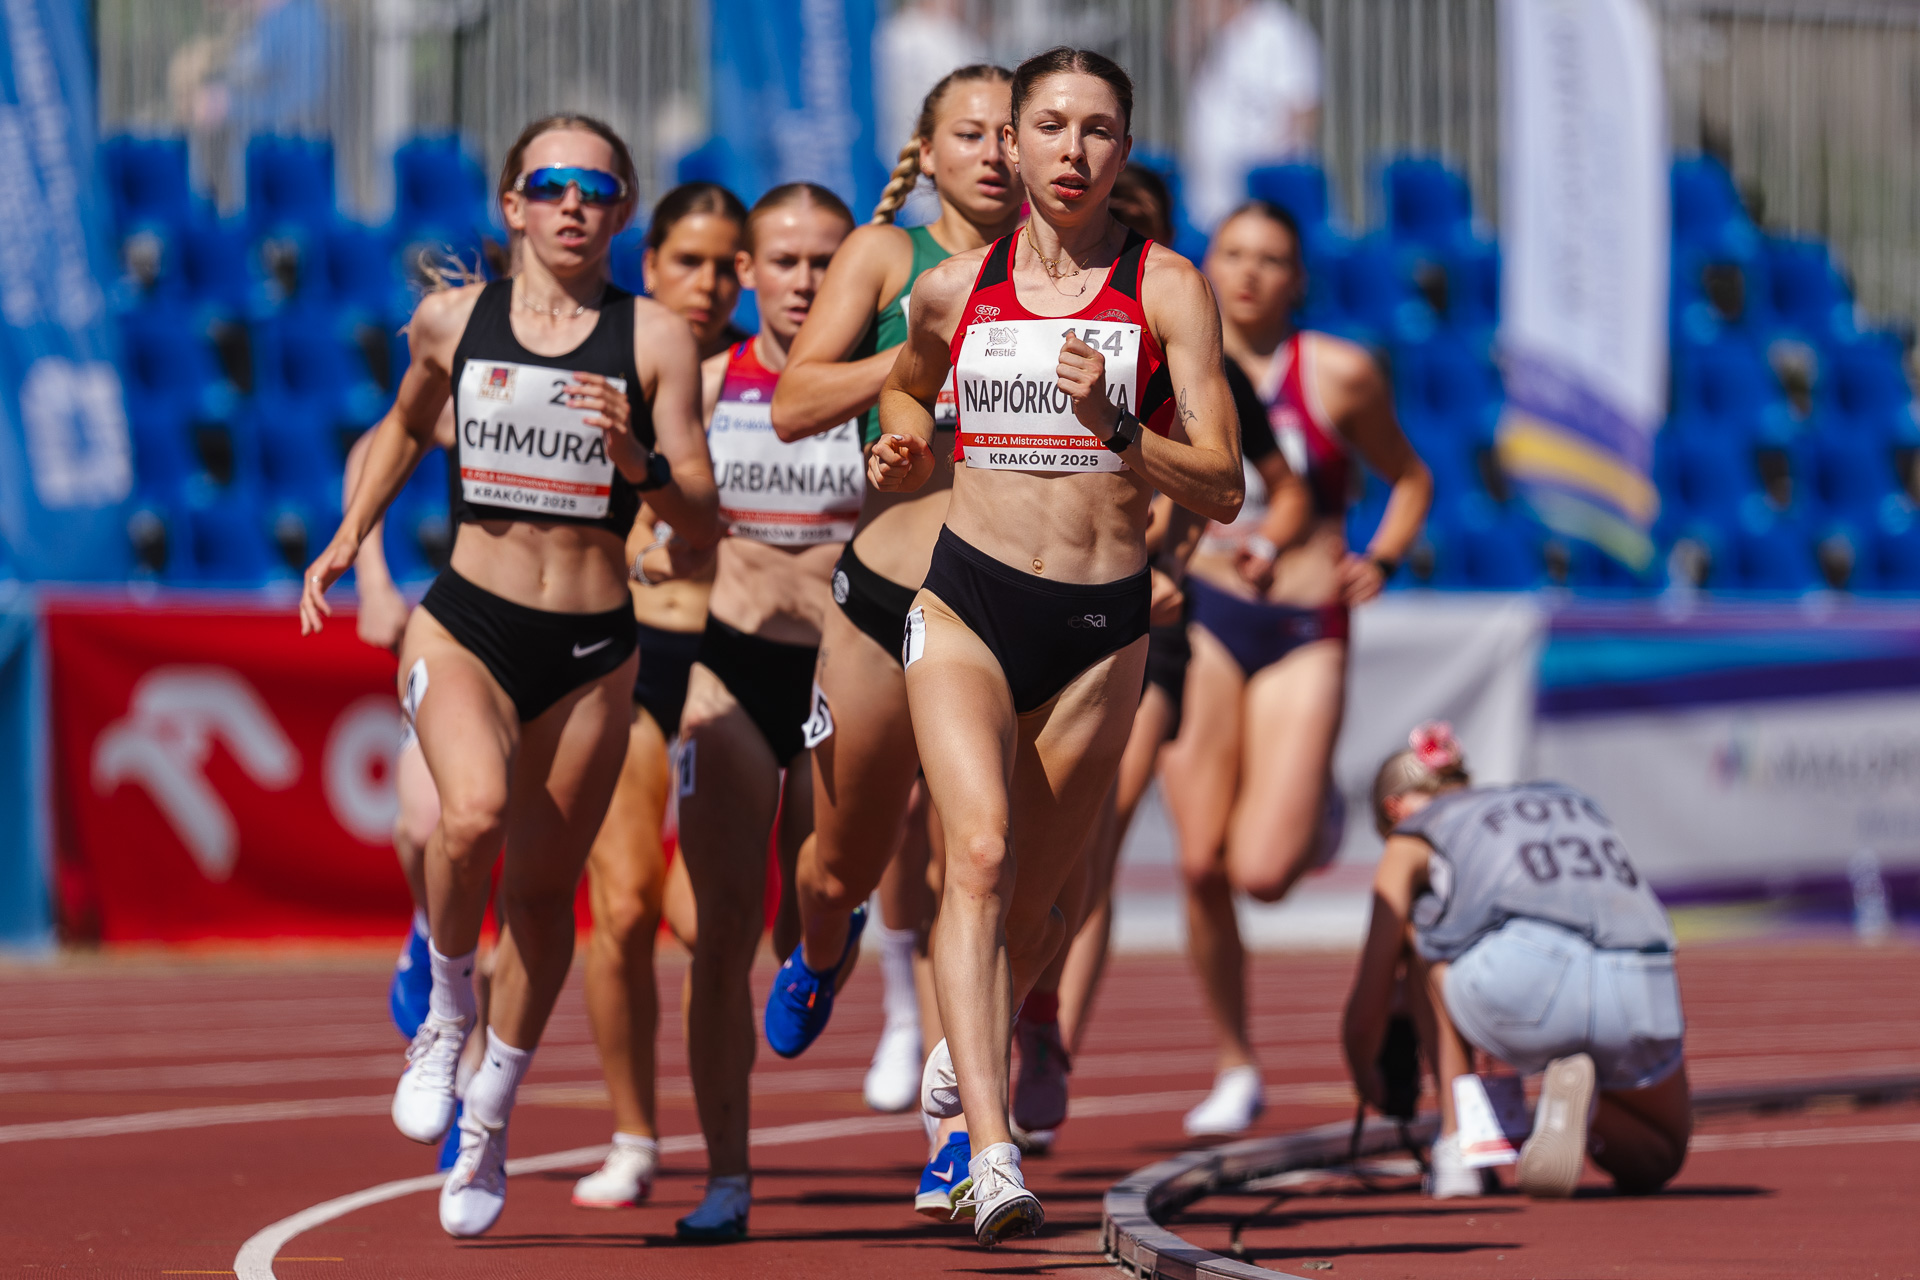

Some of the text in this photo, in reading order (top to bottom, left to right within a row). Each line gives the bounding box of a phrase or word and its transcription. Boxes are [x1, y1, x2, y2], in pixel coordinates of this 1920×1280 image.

[964, 374, 1130, 414] NAPIÓRKOA
[464, 420, 607, 466] CHMURA
[974, 436, 987, 444] 42.
[988, 436, 1008, 445] PZLA
[1010, 436, 1067, 447] Mistrzostwa
[1069, 438, 1098, 447] Polski
[989, 451, 1098, 466] KRAKÓW 2025
